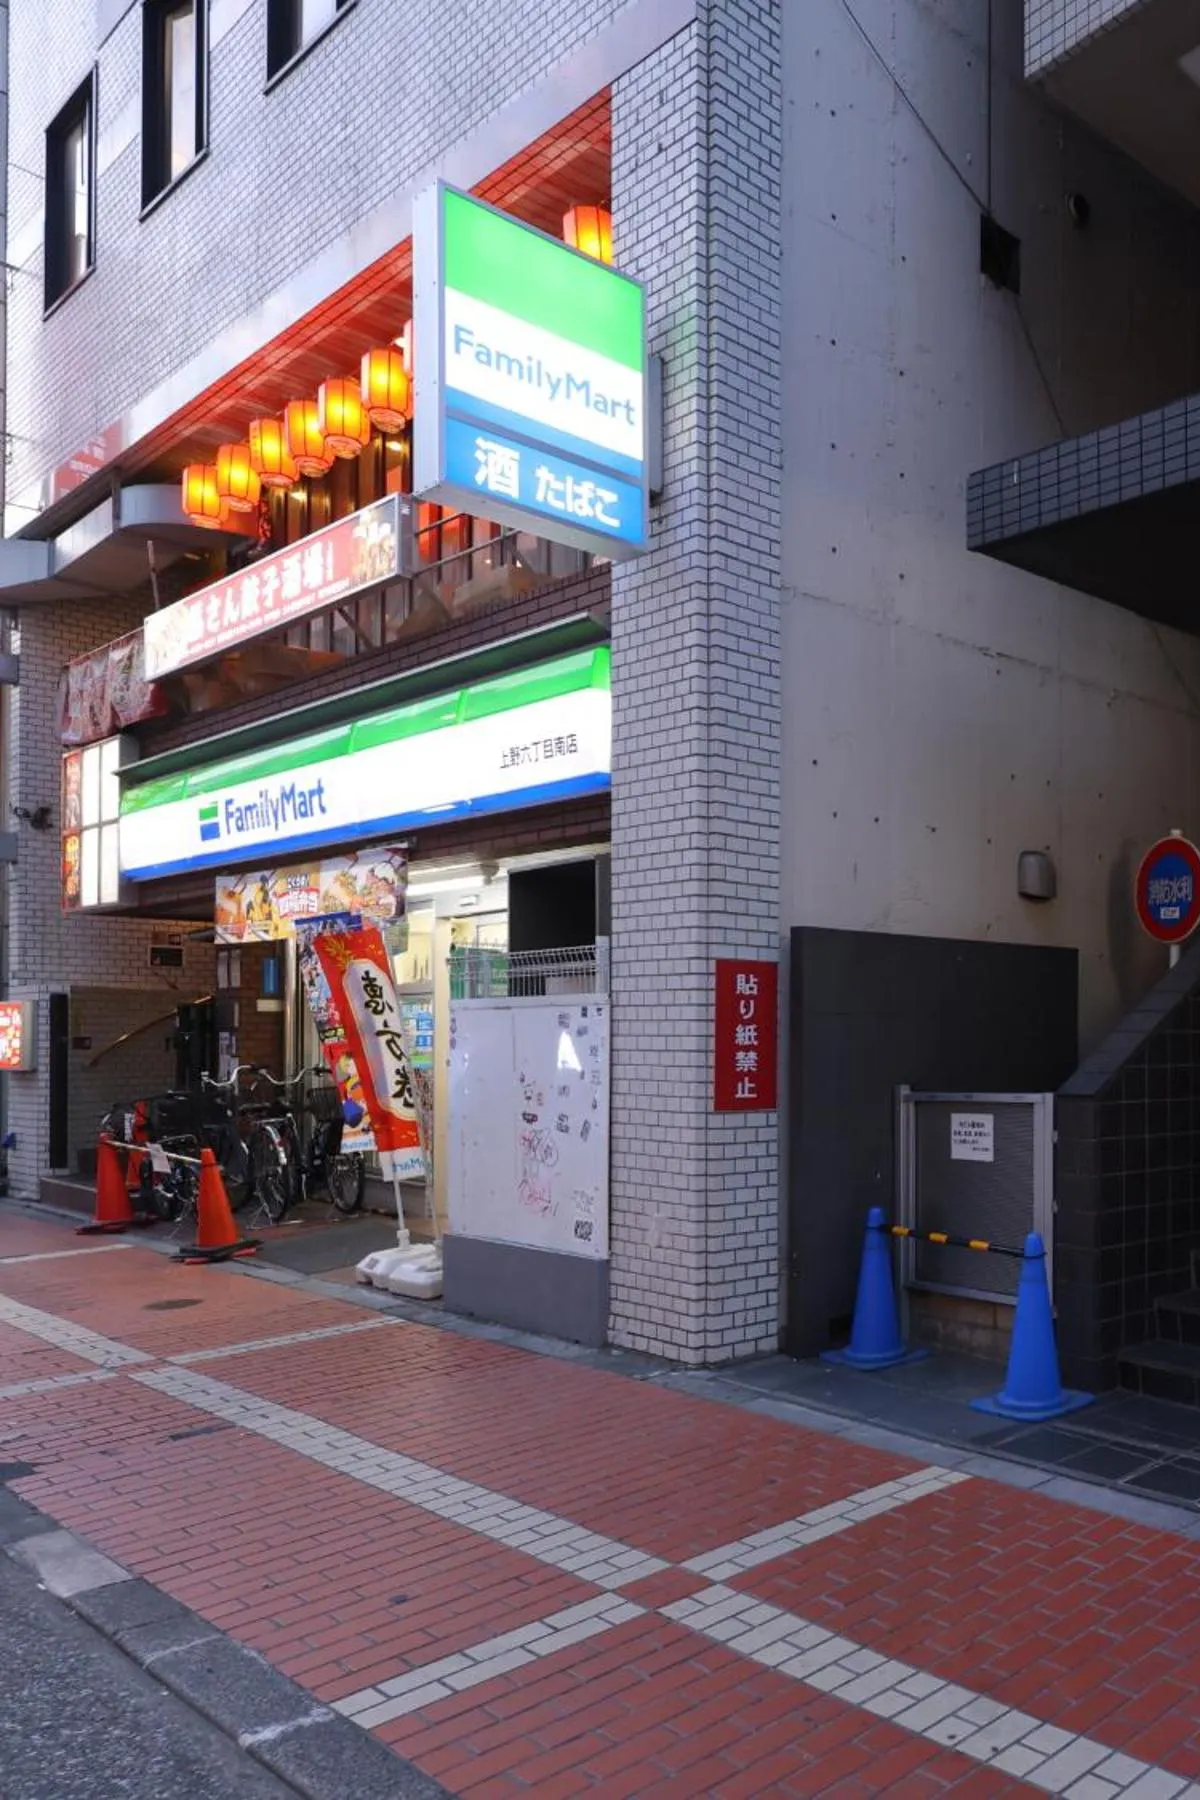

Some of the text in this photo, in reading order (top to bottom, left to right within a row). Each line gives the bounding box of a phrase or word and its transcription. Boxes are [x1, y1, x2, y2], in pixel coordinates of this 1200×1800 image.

[453, 323, 636, 426] FamilyMart
[473, 436, 621, 529] 酒 たばこ
[223, 778, 328, 836] FamilyMart
[734, 973, 759, 1099] 貼り紙禁止
